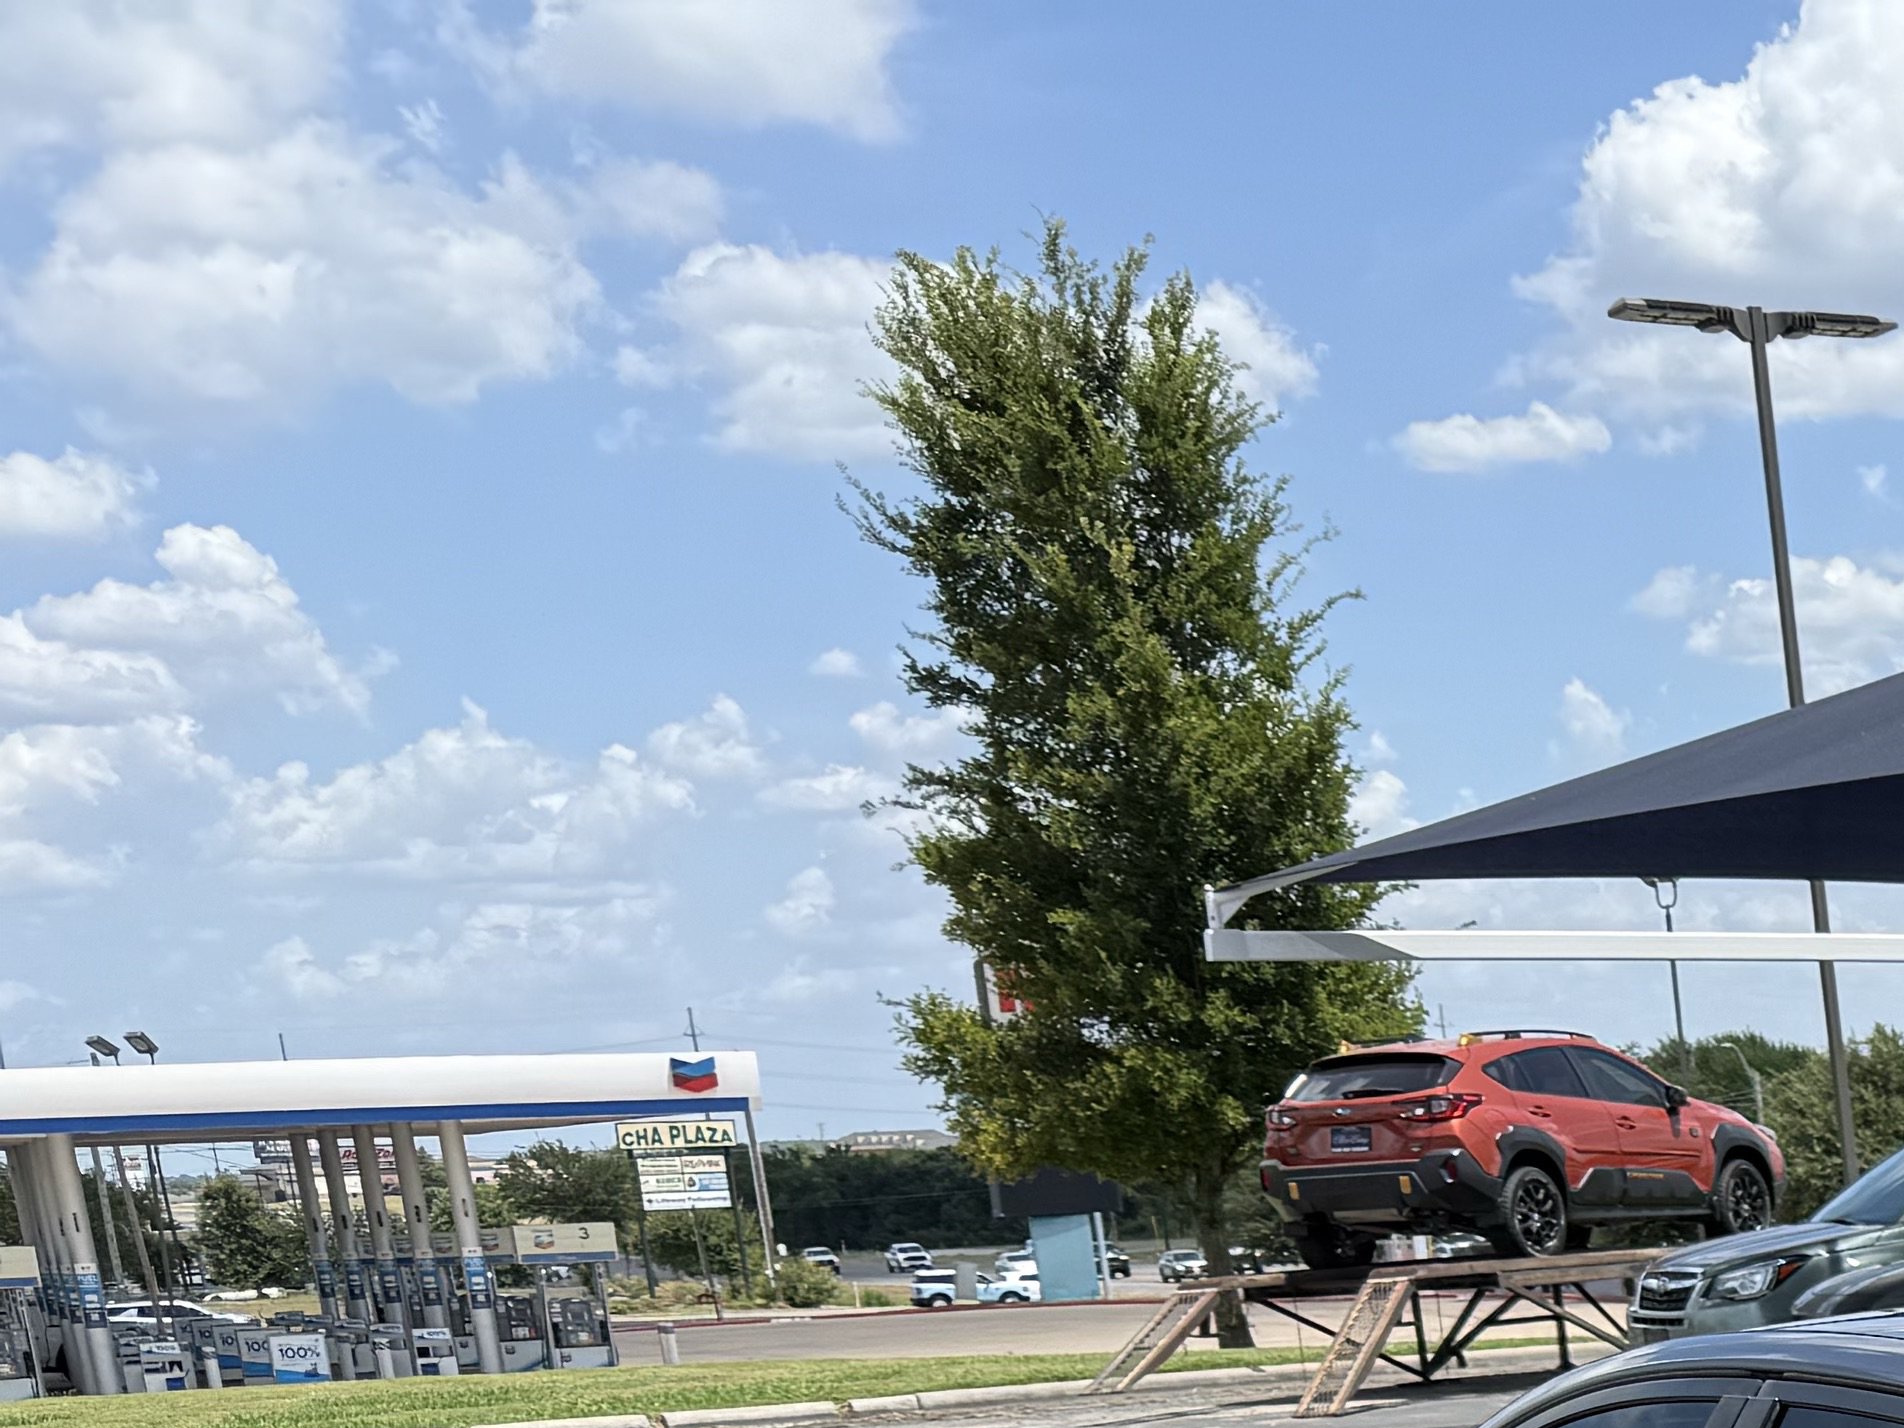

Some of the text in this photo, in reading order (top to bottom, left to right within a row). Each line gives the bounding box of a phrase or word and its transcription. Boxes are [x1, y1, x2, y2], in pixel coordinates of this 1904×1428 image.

[621, 1125, 732, 1146] CHA PLAZA
[579, 1227, 590, 1240] 3
[278, 1346, 321, 1358] 100%
